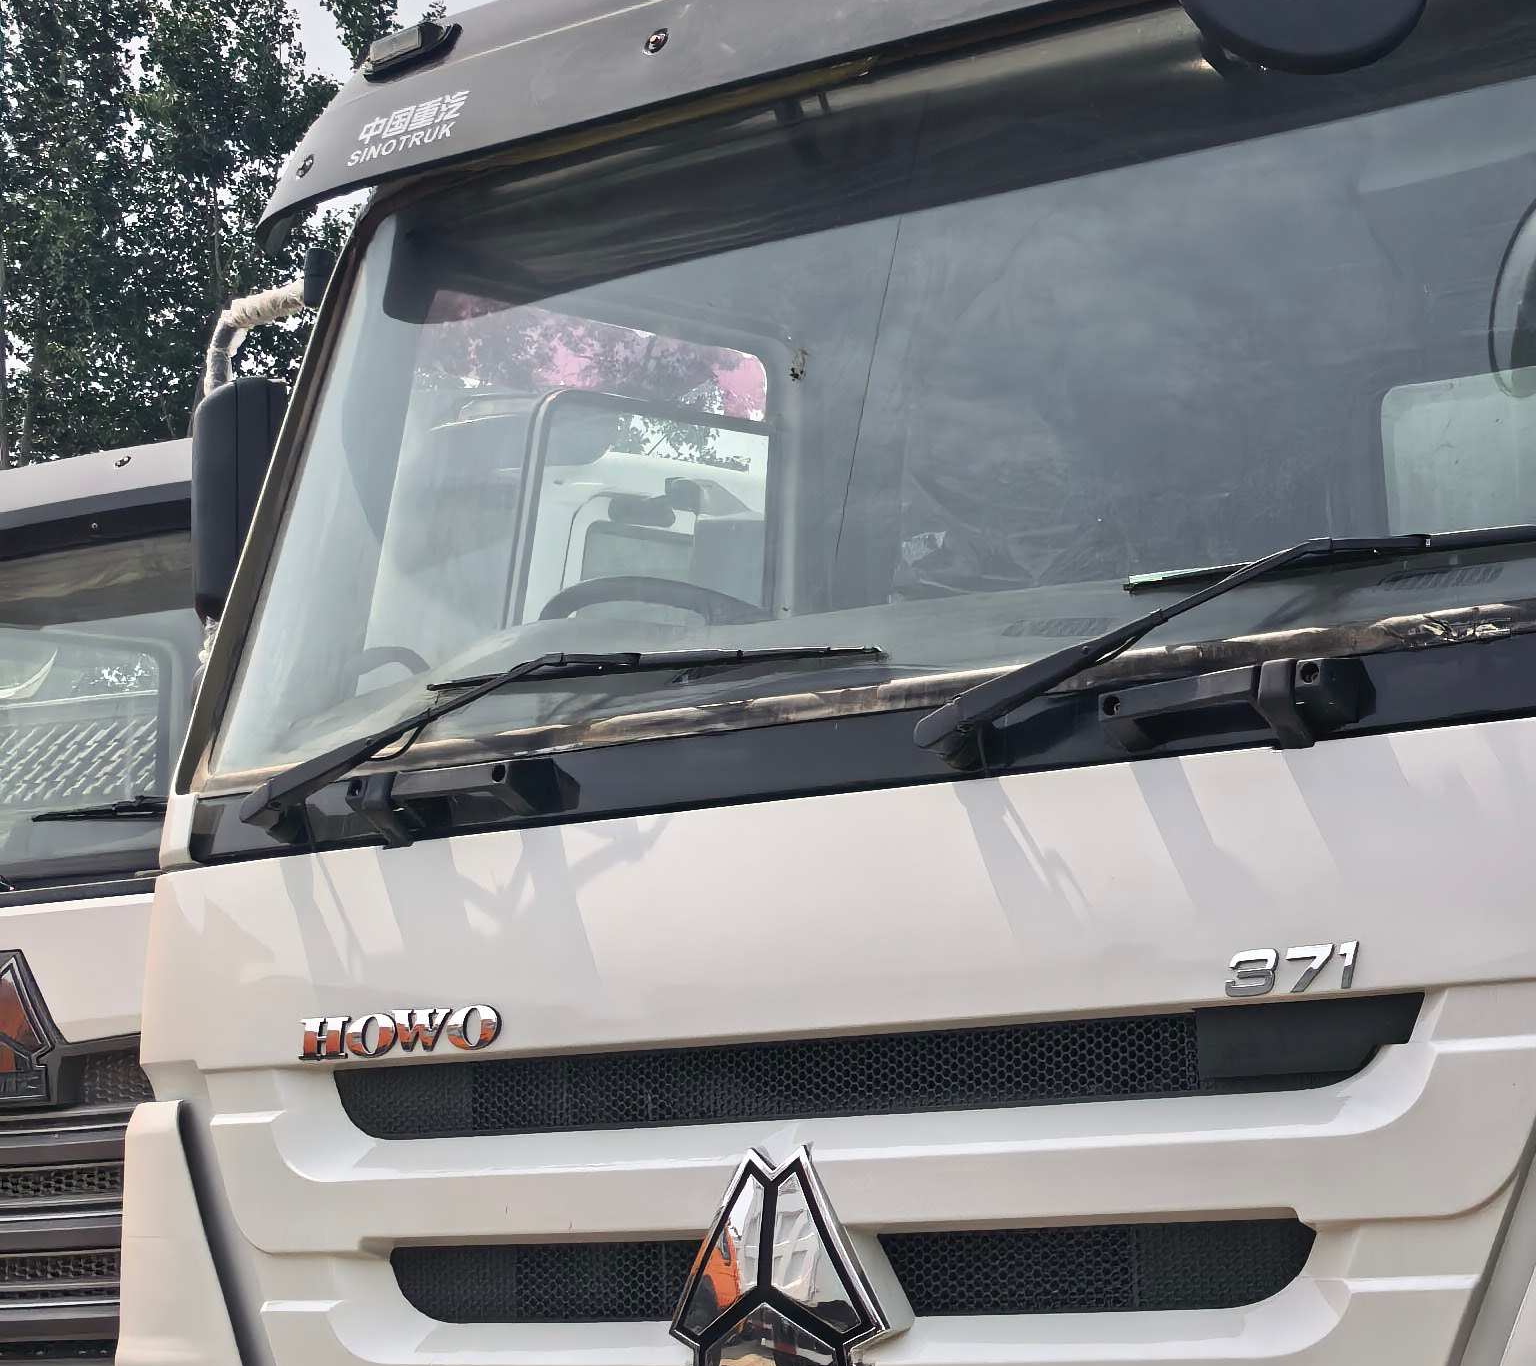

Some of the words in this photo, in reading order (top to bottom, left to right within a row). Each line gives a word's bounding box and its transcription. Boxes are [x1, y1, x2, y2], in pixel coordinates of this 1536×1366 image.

[346, 121, 456, 167] SINOTRUK
[358, 90, 470, 144] 中国重汽
[1225, 940, 1359, 997] 371
[298, 1004, 502, 1061] HOWO
